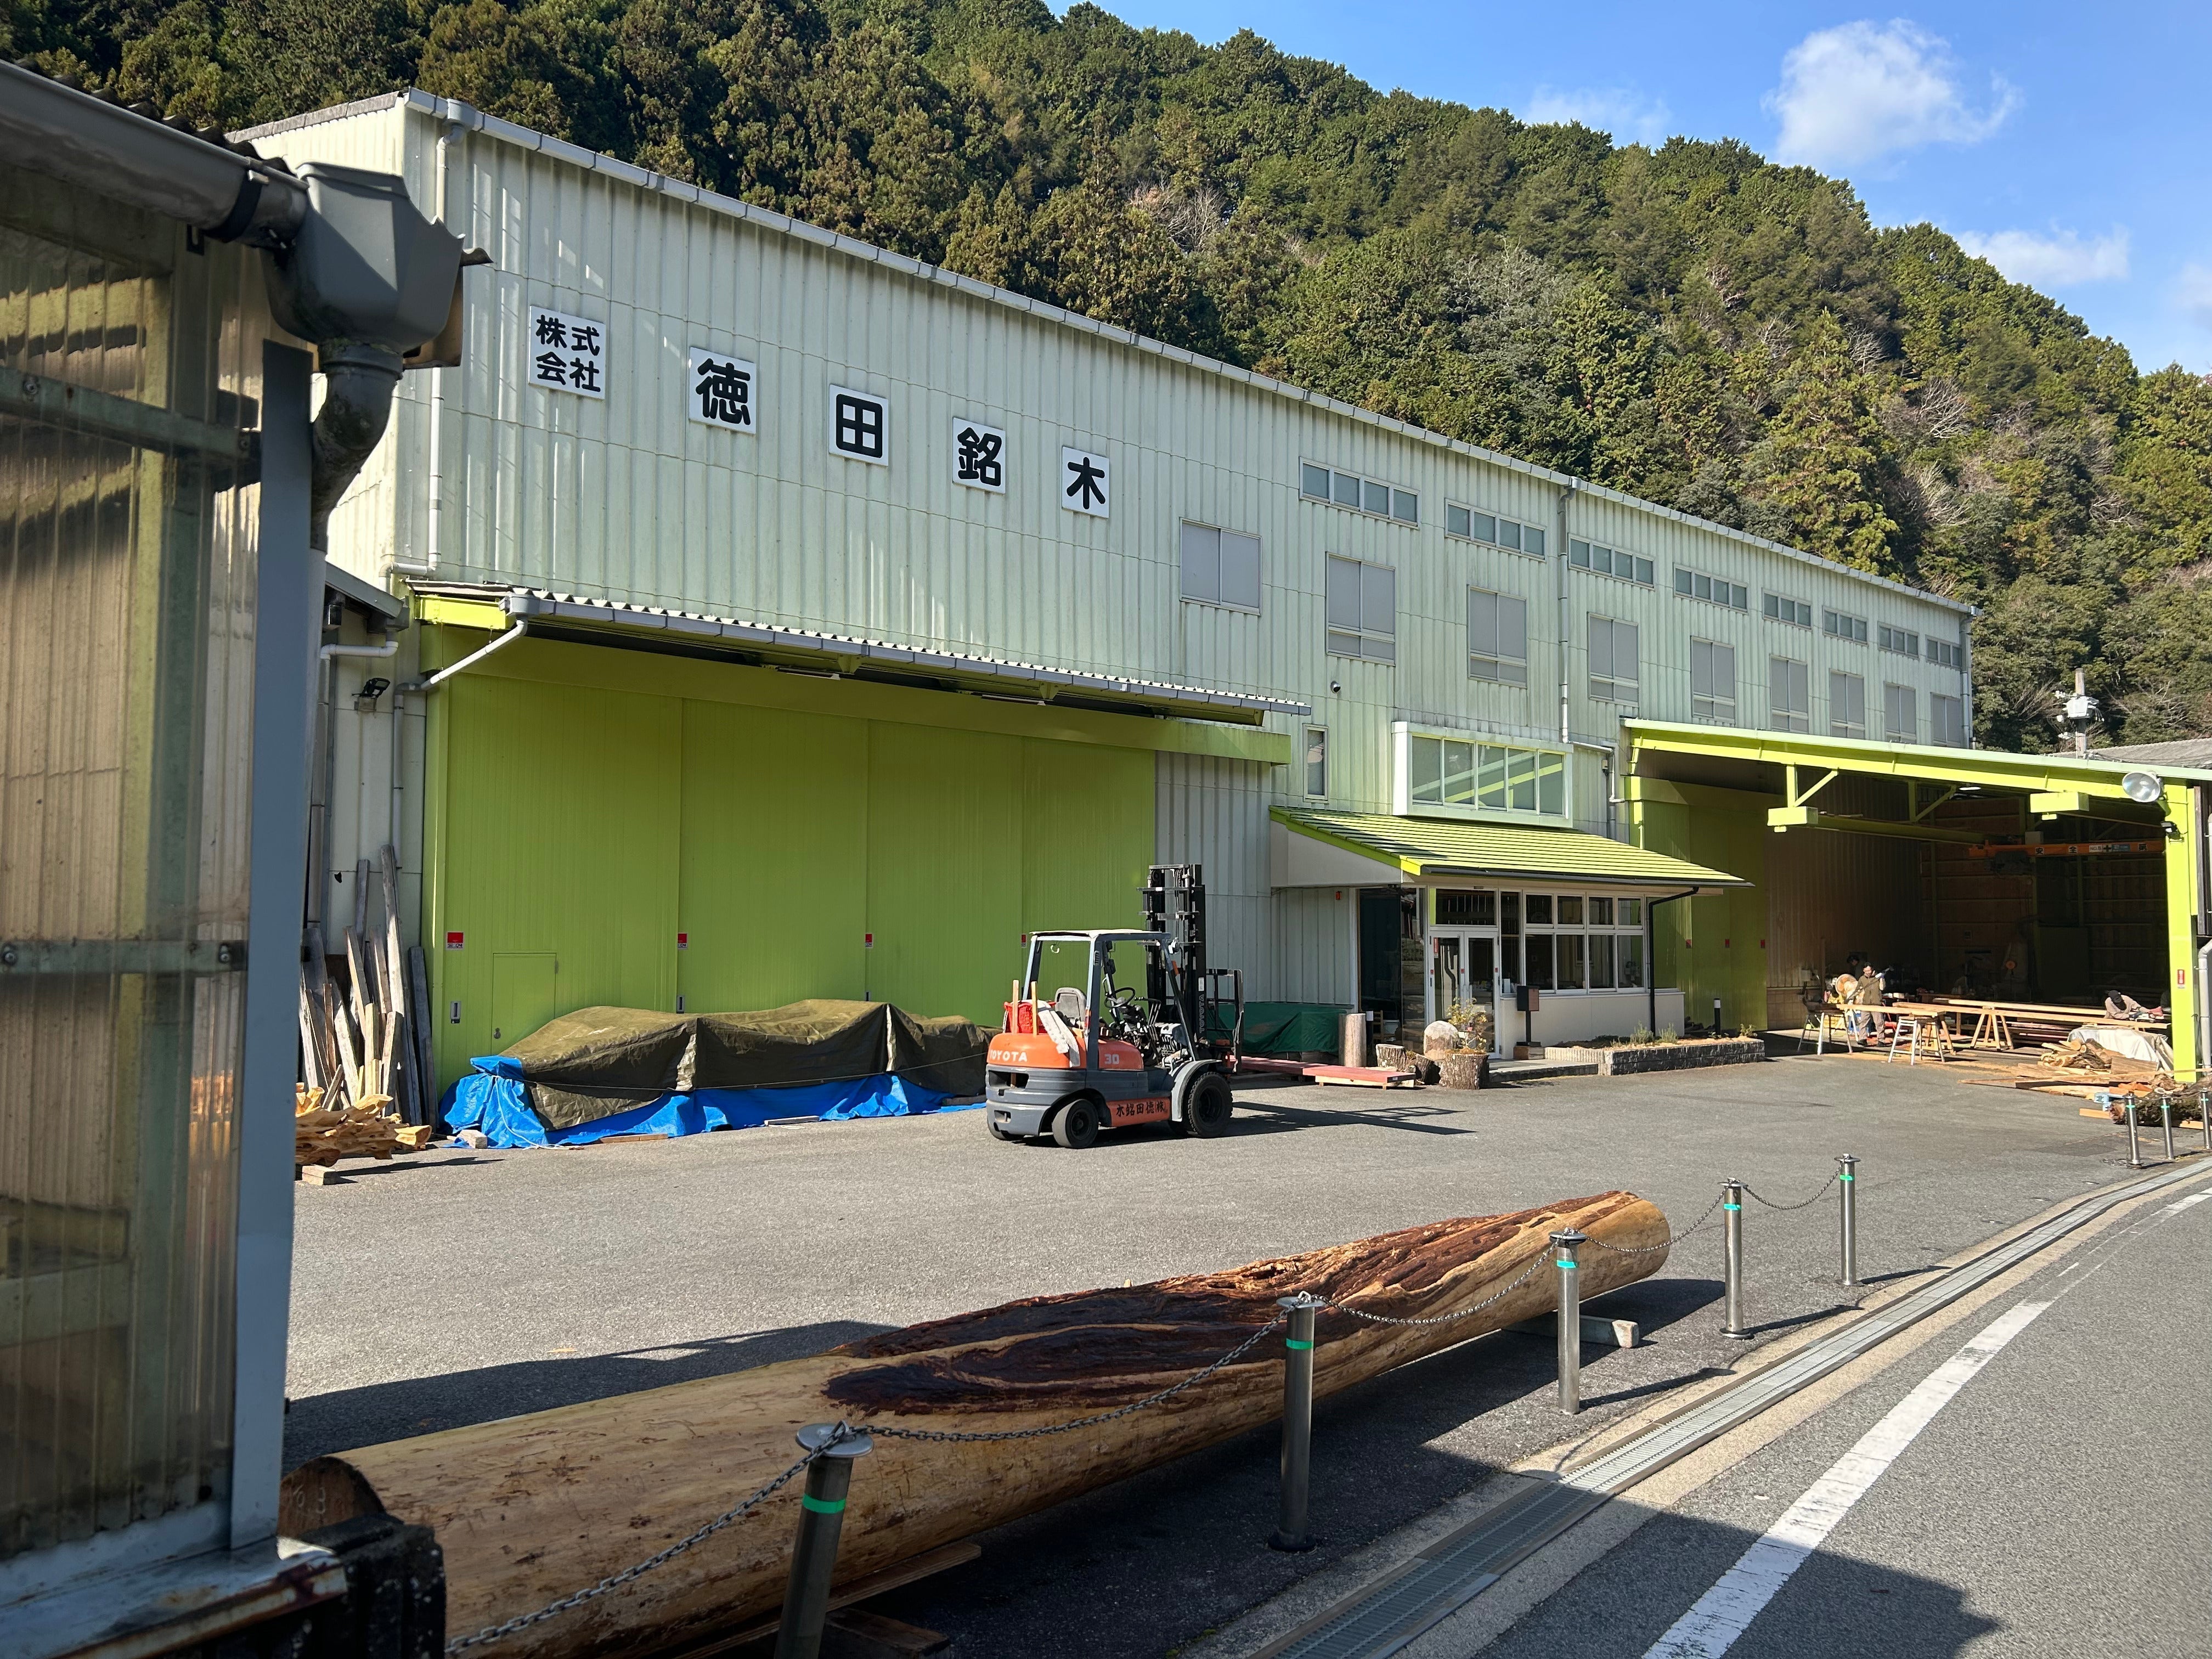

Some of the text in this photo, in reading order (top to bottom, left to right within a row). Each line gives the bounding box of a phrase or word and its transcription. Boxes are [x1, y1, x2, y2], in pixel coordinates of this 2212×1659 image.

[535, 314, 600, 356] 株式
[535, 351, 601, 393] 会社
[696, 358, 1106, 509] 徳田銘木
[990, 1050, 1028, 1062] TOYOTA
[1104, 1054, 1119, 1064] 30
